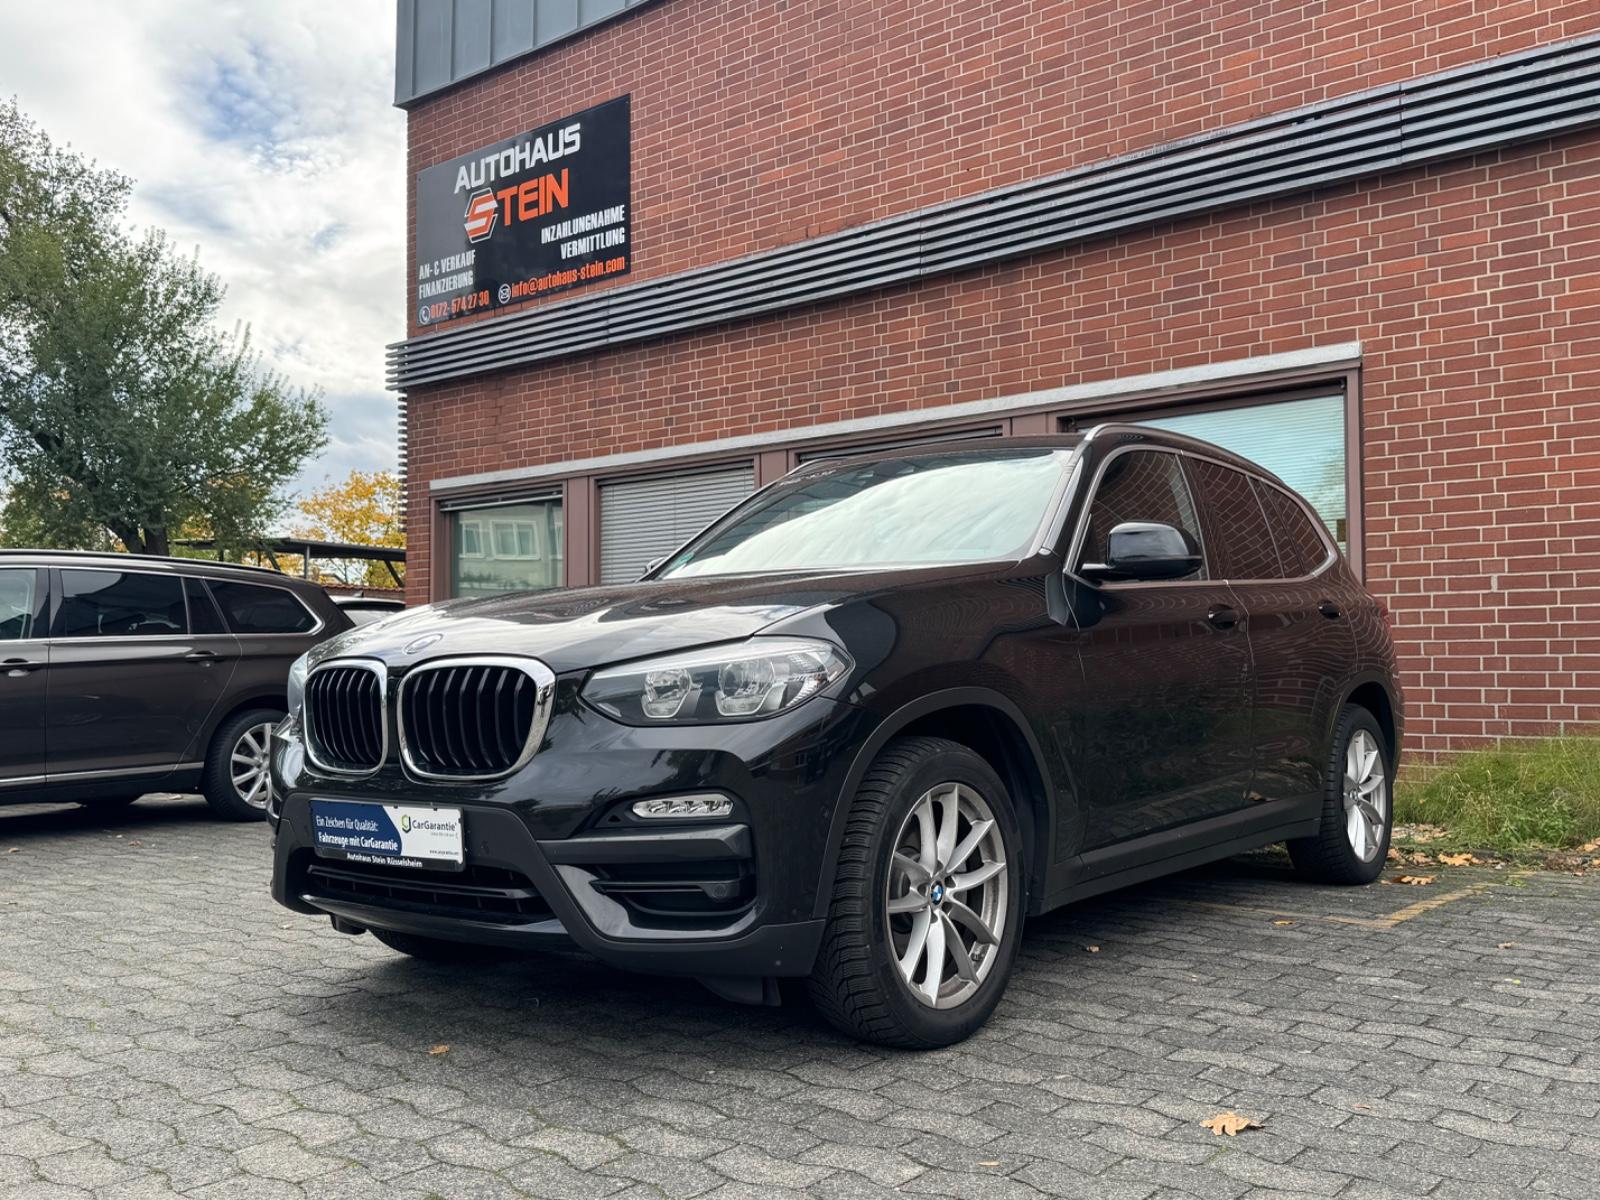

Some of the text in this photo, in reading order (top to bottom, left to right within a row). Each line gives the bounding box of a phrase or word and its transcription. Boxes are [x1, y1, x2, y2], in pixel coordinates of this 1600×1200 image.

[454, 123, 581, 194] AUTOHAUS
[541, 204, 625, 244] INZAHLUNGNAHME
[560, 227, 625, 260] VERMITTLUNG
[441, 249, 476, 273] VERKAUF
[419, 270, 474, 300] FINANZIERUNG
[511, 256, 625, 298] info@autohaus-stein.com
[316, 815, 325, 827] Ein
[325, 816, 346, 829] Zeichen
[346, 818, 354, 830] für
[318, 832, 399, 851] Fahrzeuge mit CarGarantie
[347, 852, 372, 863] Autohaus
[372, 855, 387, 865] Stein
